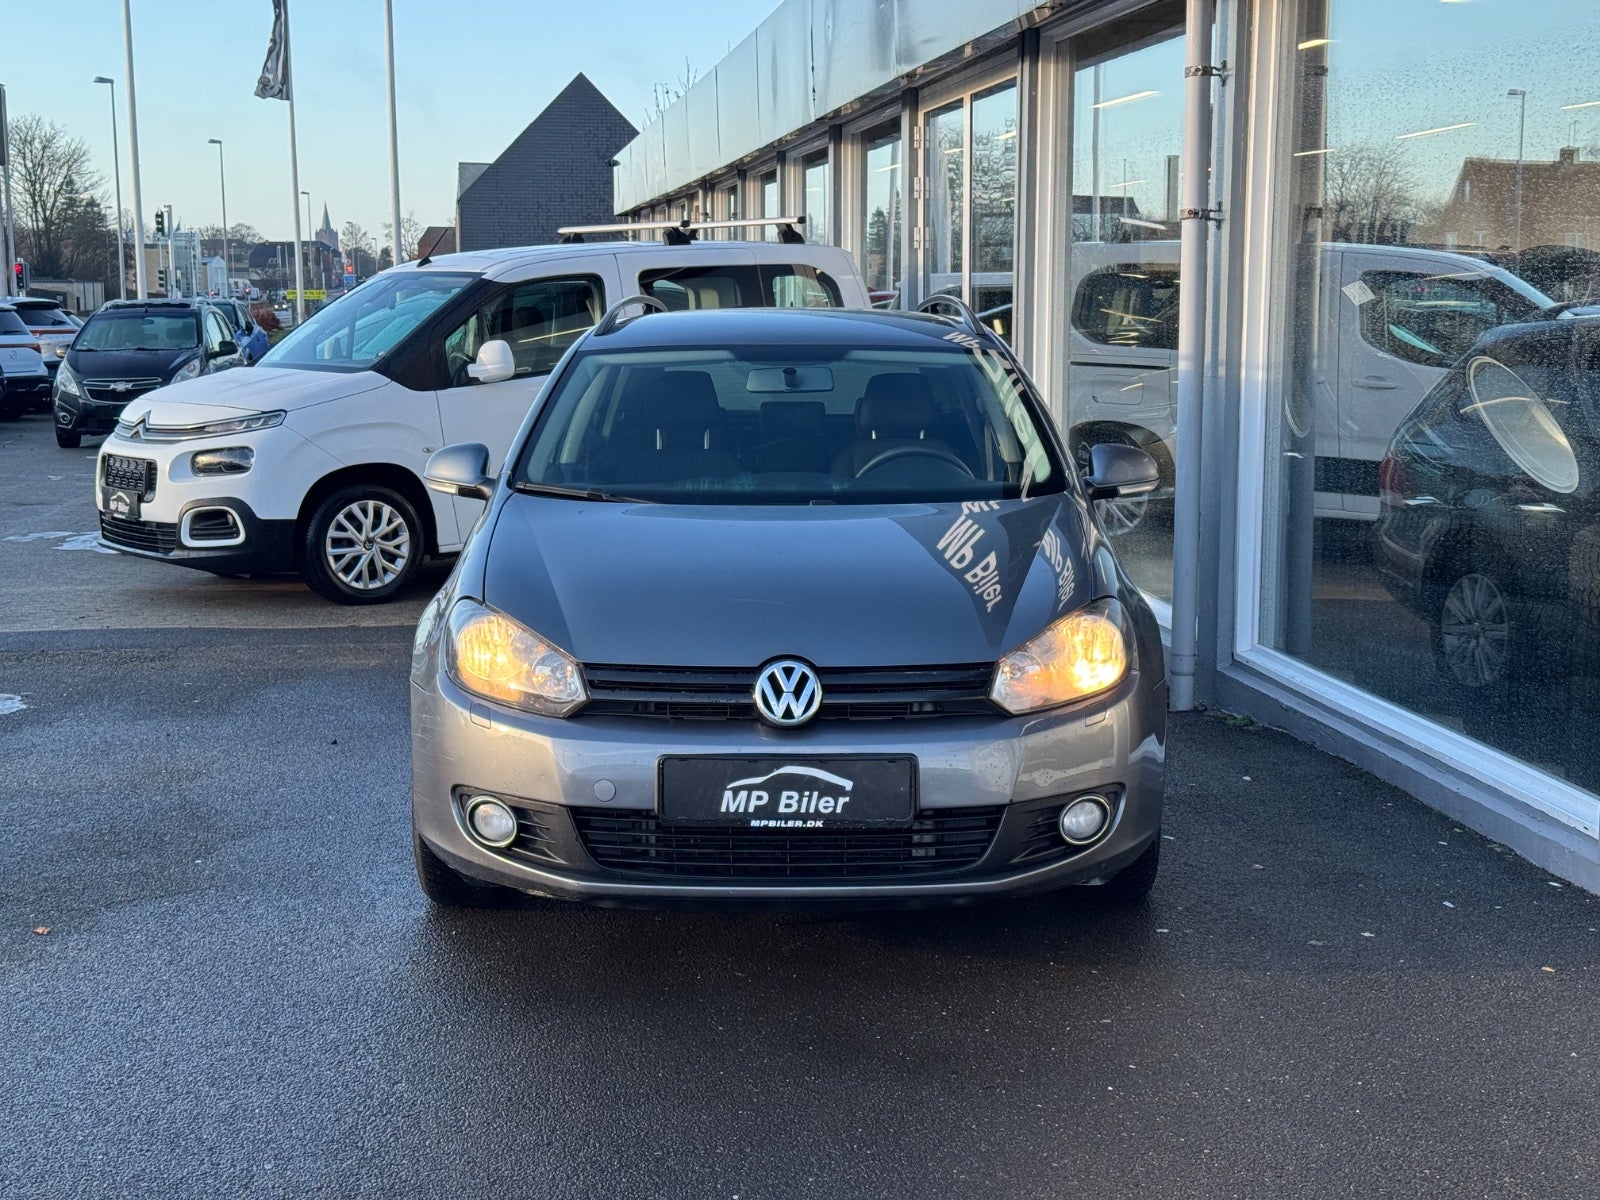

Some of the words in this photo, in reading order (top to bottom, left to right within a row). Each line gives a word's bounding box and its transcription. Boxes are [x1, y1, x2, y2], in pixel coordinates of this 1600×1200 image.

[756, 660, 821, 723] VW
[720, 790, 769, 813] MP
[778, 790, 850, 813] Biler
[750, 819, 824, 828] MPBILER.DK
